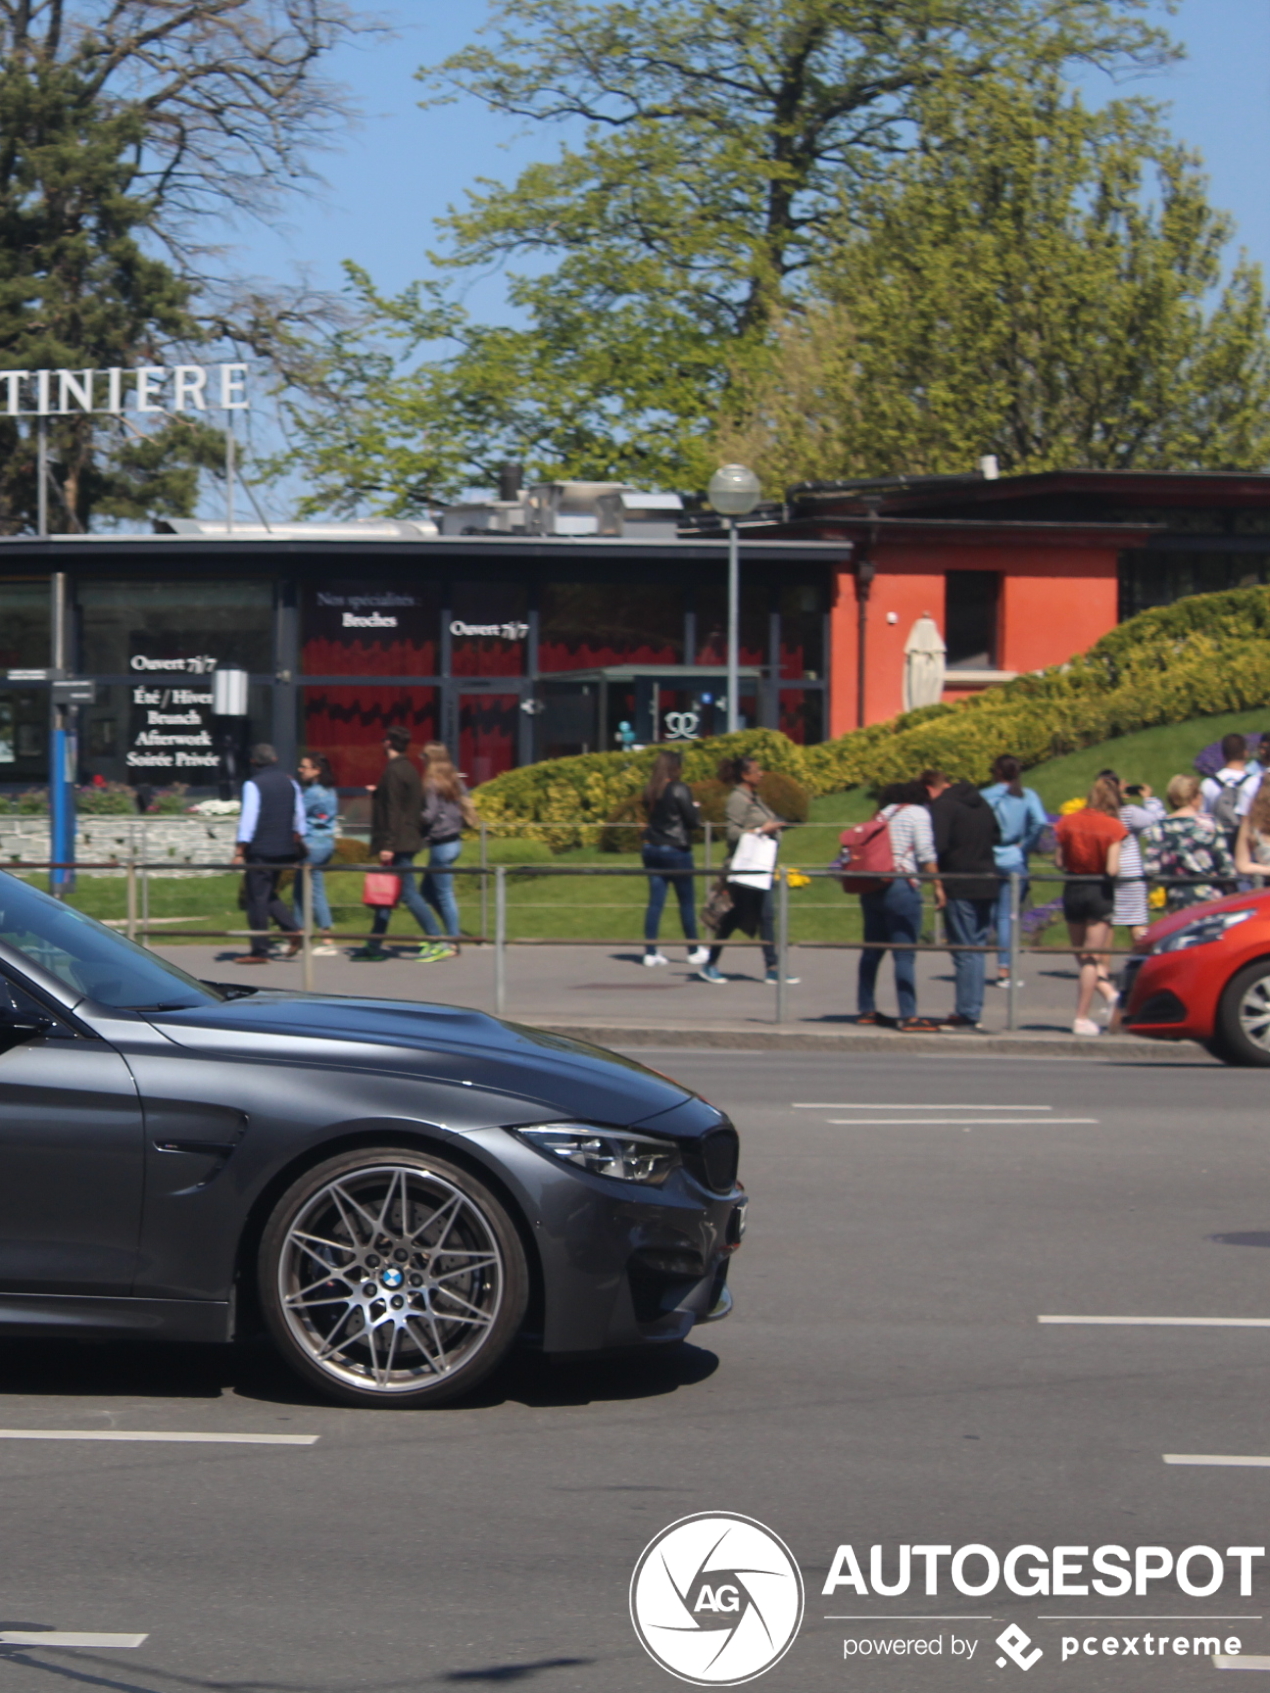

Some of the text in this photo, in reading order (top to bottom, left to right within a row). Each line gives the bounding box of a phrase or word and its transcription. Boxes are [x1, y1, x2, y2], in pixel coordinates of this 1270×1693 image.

[342, 611, 399, 628] Broches
[449, 620, 499, 636] Ouvert
[130, 654, 218, 674] Ouvert 7j/7
[133, 685, 161, 705] Été
[147, 709, 202, 725] Brunch
[135, 729, 213, 746] Afterwork
[126, 751, 220, 767] Soirée Privée
